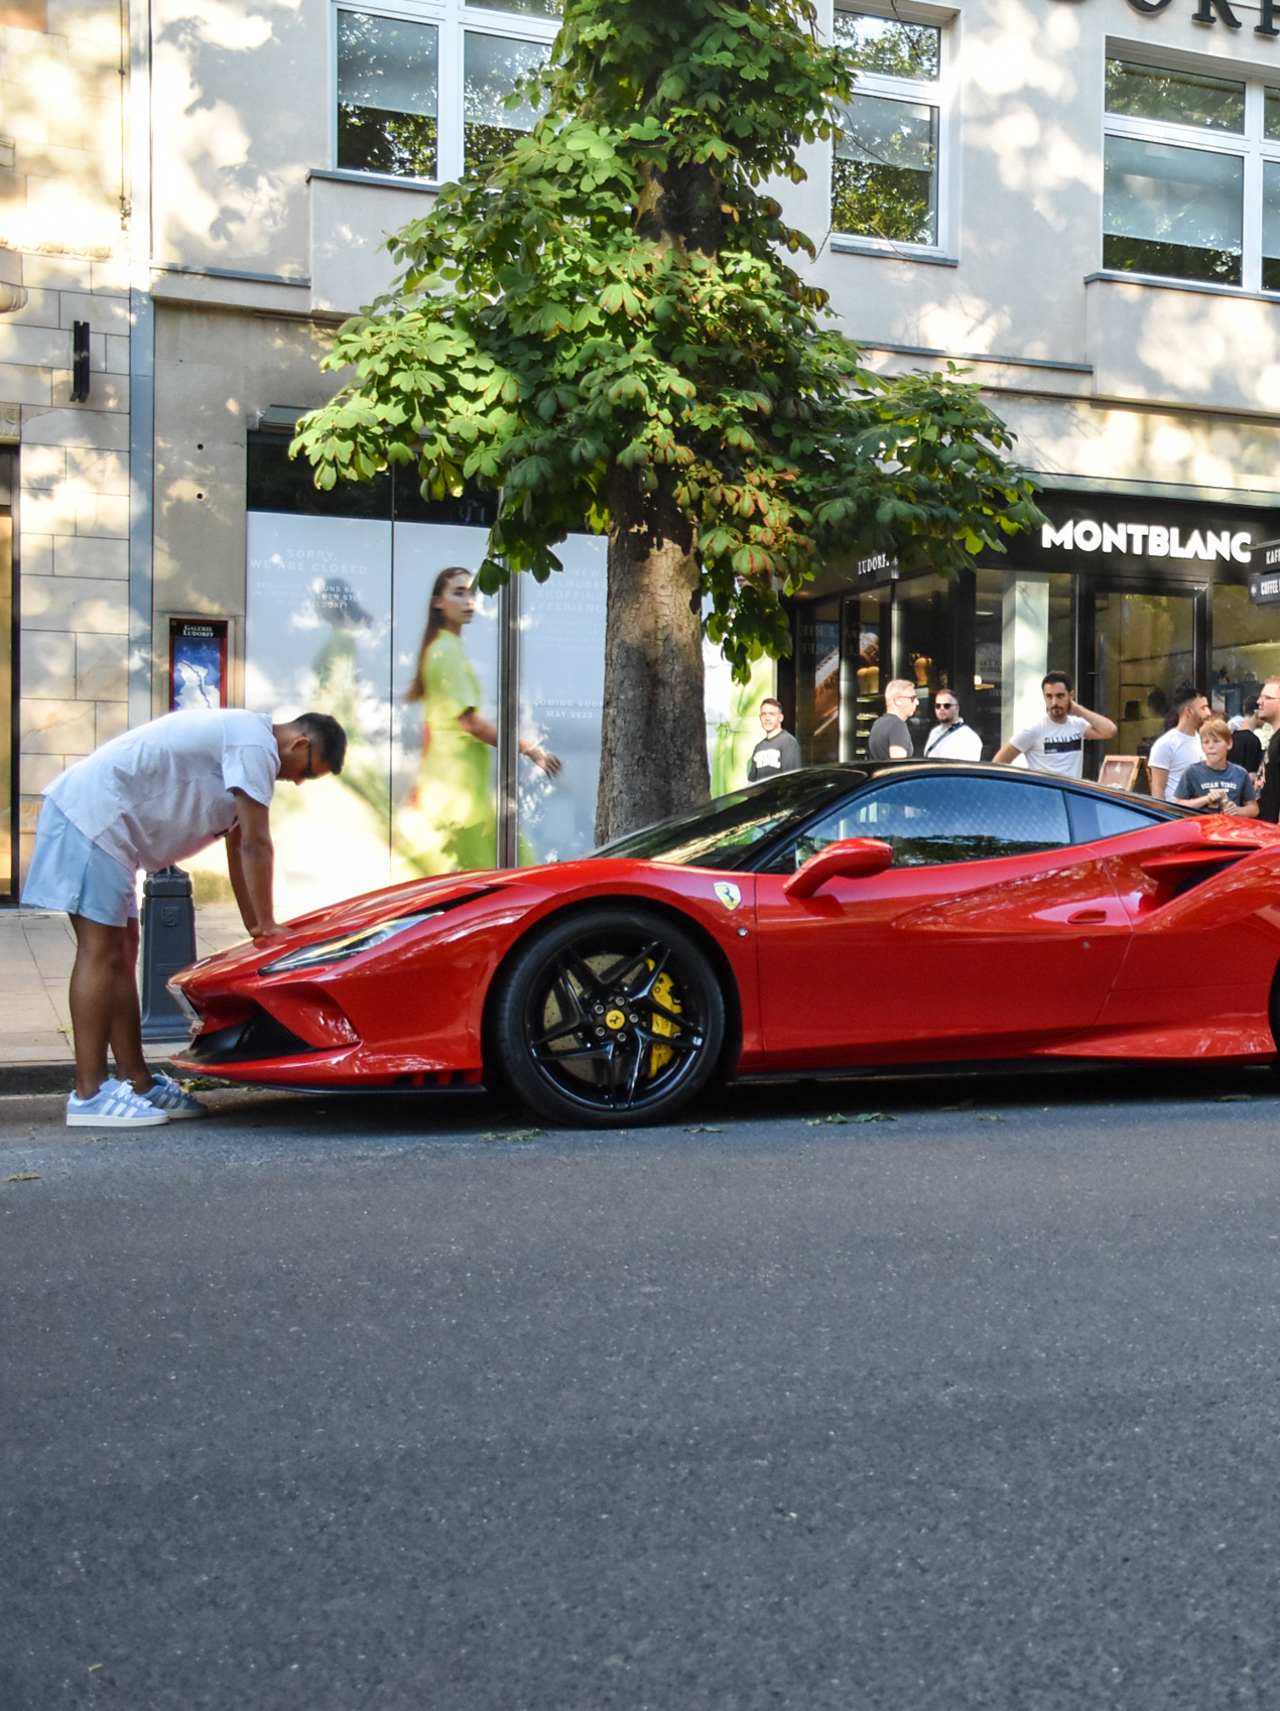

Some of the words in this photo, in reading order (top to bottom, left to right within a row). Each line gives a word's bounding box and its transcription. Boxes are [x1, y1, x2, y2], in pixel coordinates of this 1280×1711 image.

[1042, 518, 1251, 563] MONTBLANC
[250, 558, 271, 569] WE
[277, 561, 305, 571] ARE
[858, 553, 889, 575] LUDORF
[1260, 578, 1279, 596] COFFEE
[533, 699, 574, 707] COMING
[1201, 781, 1219, 790] OCEAN
[1220, 781, 1237, 790] VIBES
